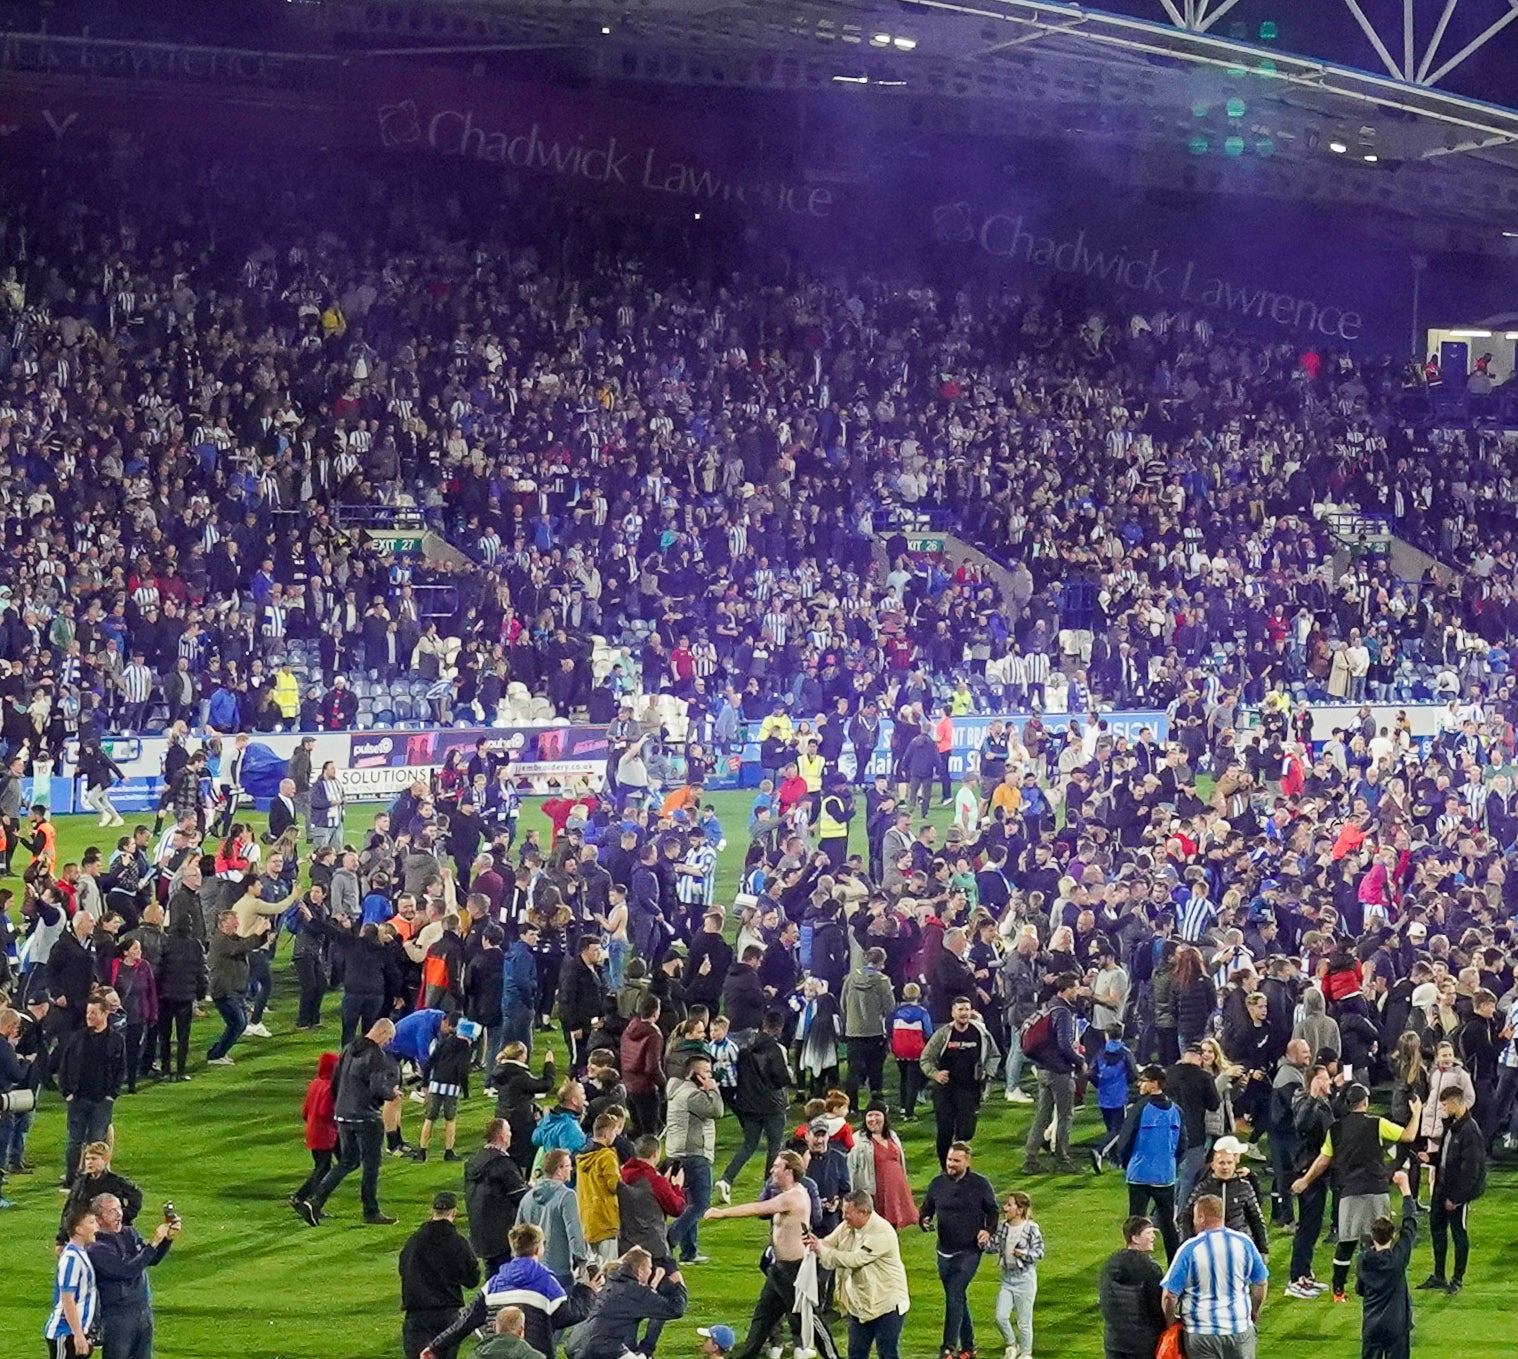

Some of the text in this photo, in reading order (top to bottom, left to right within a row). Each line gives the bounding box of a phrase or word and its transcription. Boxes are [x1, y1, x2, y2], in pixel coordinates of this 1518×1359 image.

[428, 109, 629, 185] Chadwick
[980, 213, 1362, 341] Chadwick Lawrence
[372, 539, 415, 550] EXIT 27
[907, 539, 938, 551] XIT 26
[342, 768, 427, 785] SOLUTIONS
